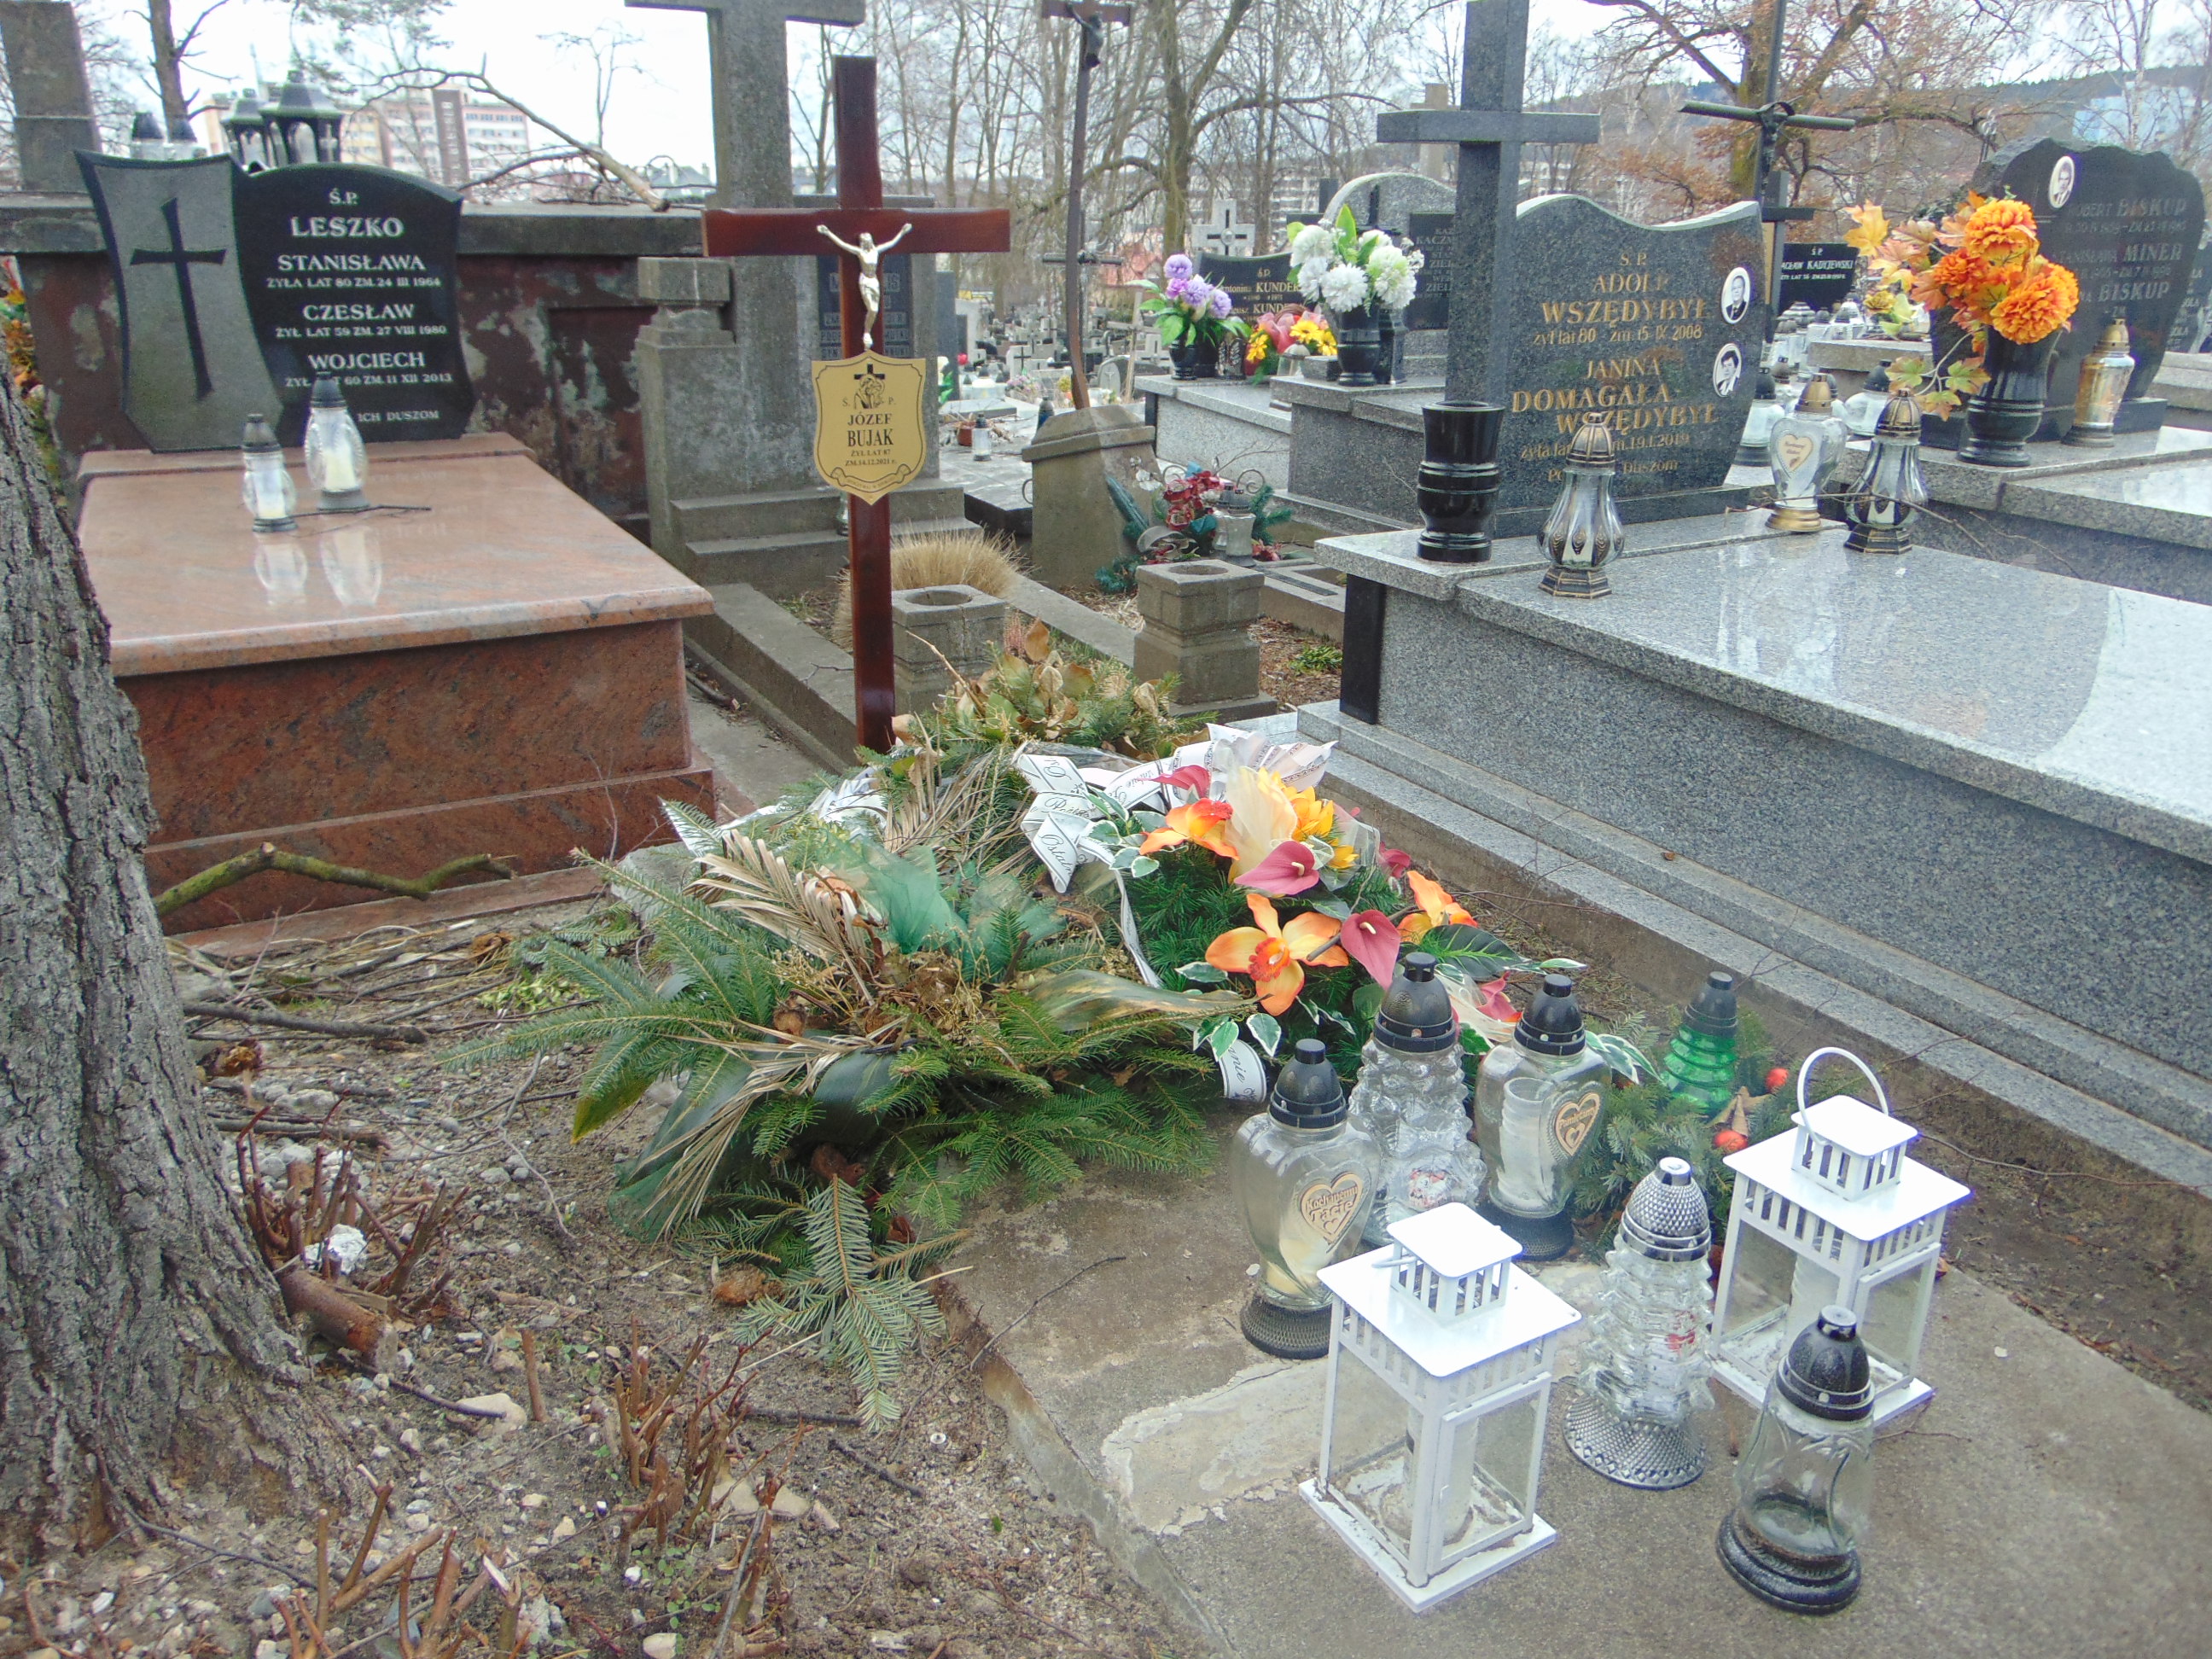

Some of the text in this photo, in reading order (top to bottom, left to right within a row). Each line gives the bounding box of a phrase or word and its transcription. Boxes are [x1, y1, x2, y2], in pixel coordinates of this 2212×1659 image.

[328, 188, 359, 205] Ś.P.
[290, 216, 405, 237] LESZKO
[2122, 243, 2183, 261] MINER
[277, 254, 427, 271] STANISŁAWA
[306, 277, 333, 288] LAT
[335, 277, 352, 288] 80
[377, 277, 392, 288] 24
[397, 276, 410, 287] III
[414, 276, 441, 287] 1964
[2096, 282, 2172, 302] BISKUP
[302, 304, 415, 321] CZESŁAW
[1253, 303, 1285, 313] KUND
[1541, 297, 1708, 328] WSZĘDYBYŁ
[306, 326, 331, 338] LAT
[334, 326, 351, 337] 59
[376, 326, 391, 336] 27
[395, 325, 415, 336] VIII
[419, 325, 447, 335] 1980
[1579, 328, 1598, 343] 80
[1672, 324, 1703, 341] 2008
[307, 352, 426, 370] WOJCIECH
[1585, 358, 1662, 380] JANINA
[344, 375, 361, 385] 60
[387, 375, 397, 384] 11
[401, 374, 418, 384] XII
[422, 373, 453, 383] 2013
[1512, 383, 1672, 413] DOMAGAŁA
[387, 410, 439, 422] DUSZOM
[847, 411, 893, 426] JÓZEF
[847, 428, 894, 447] BUJAK
[1309, 1200, 1354, 1223] Tacie
